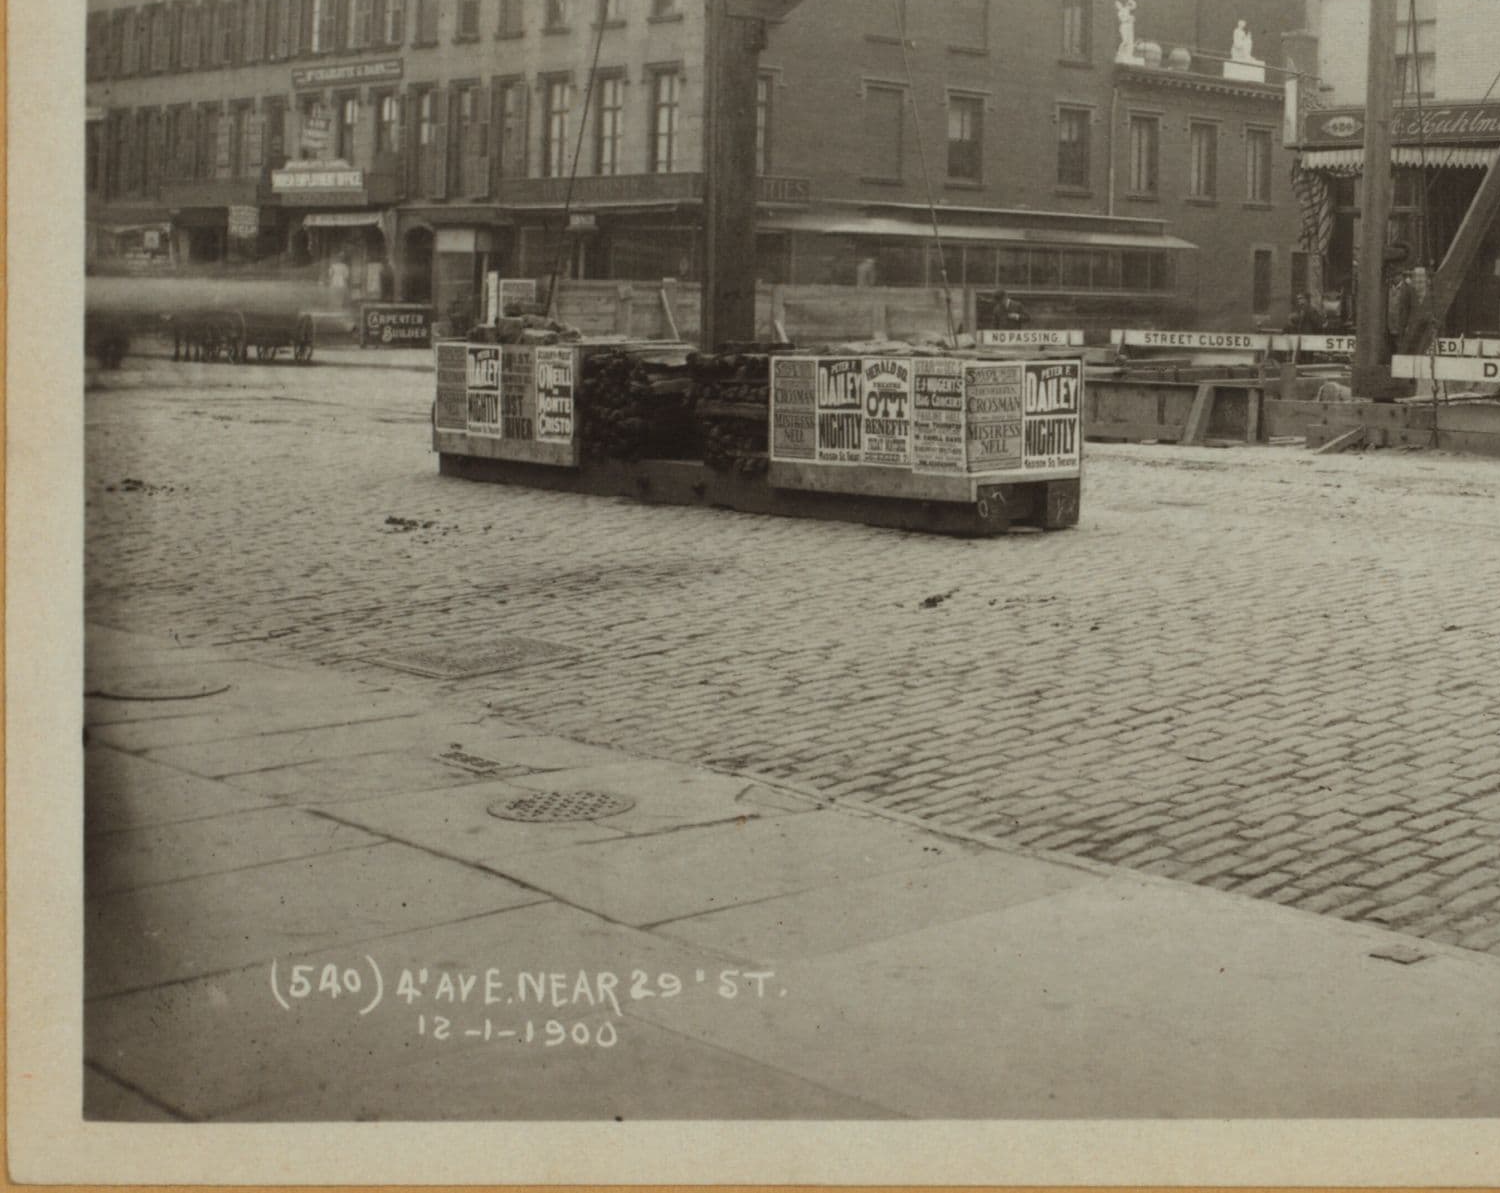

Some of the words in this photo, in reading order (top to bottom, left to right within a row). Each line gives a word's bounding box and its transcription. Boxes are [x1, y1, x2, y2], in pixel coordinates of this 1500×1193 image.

[367, 311, 424, 328] CARPENTER
[381, 325, 428, 343] BUILDER
[992, 332, 1006, 343] NO
[1144, 333, 1195, 345] STREET
[1325, 338, 1355, 350] STR
[866, 361, 897, 381] HERALD
[1041, 366, 1062, 379] PETER
[820, 367, 862, 407] DAILEY
[1026, 371, 1077, 413] DAILEY
[866, 391, 908, 417] OTT
[967, 396, 1021, 414] CROSMAN
[819, 413, 862, 449] NIGHTLY
[865, 418, 910, 436] BENEFIT
[967, 422, 1021, 440] MISTRESS
[1025, 418, 1077, 456] NIGHTLY
[980, 439, 1009, 455] NELL
